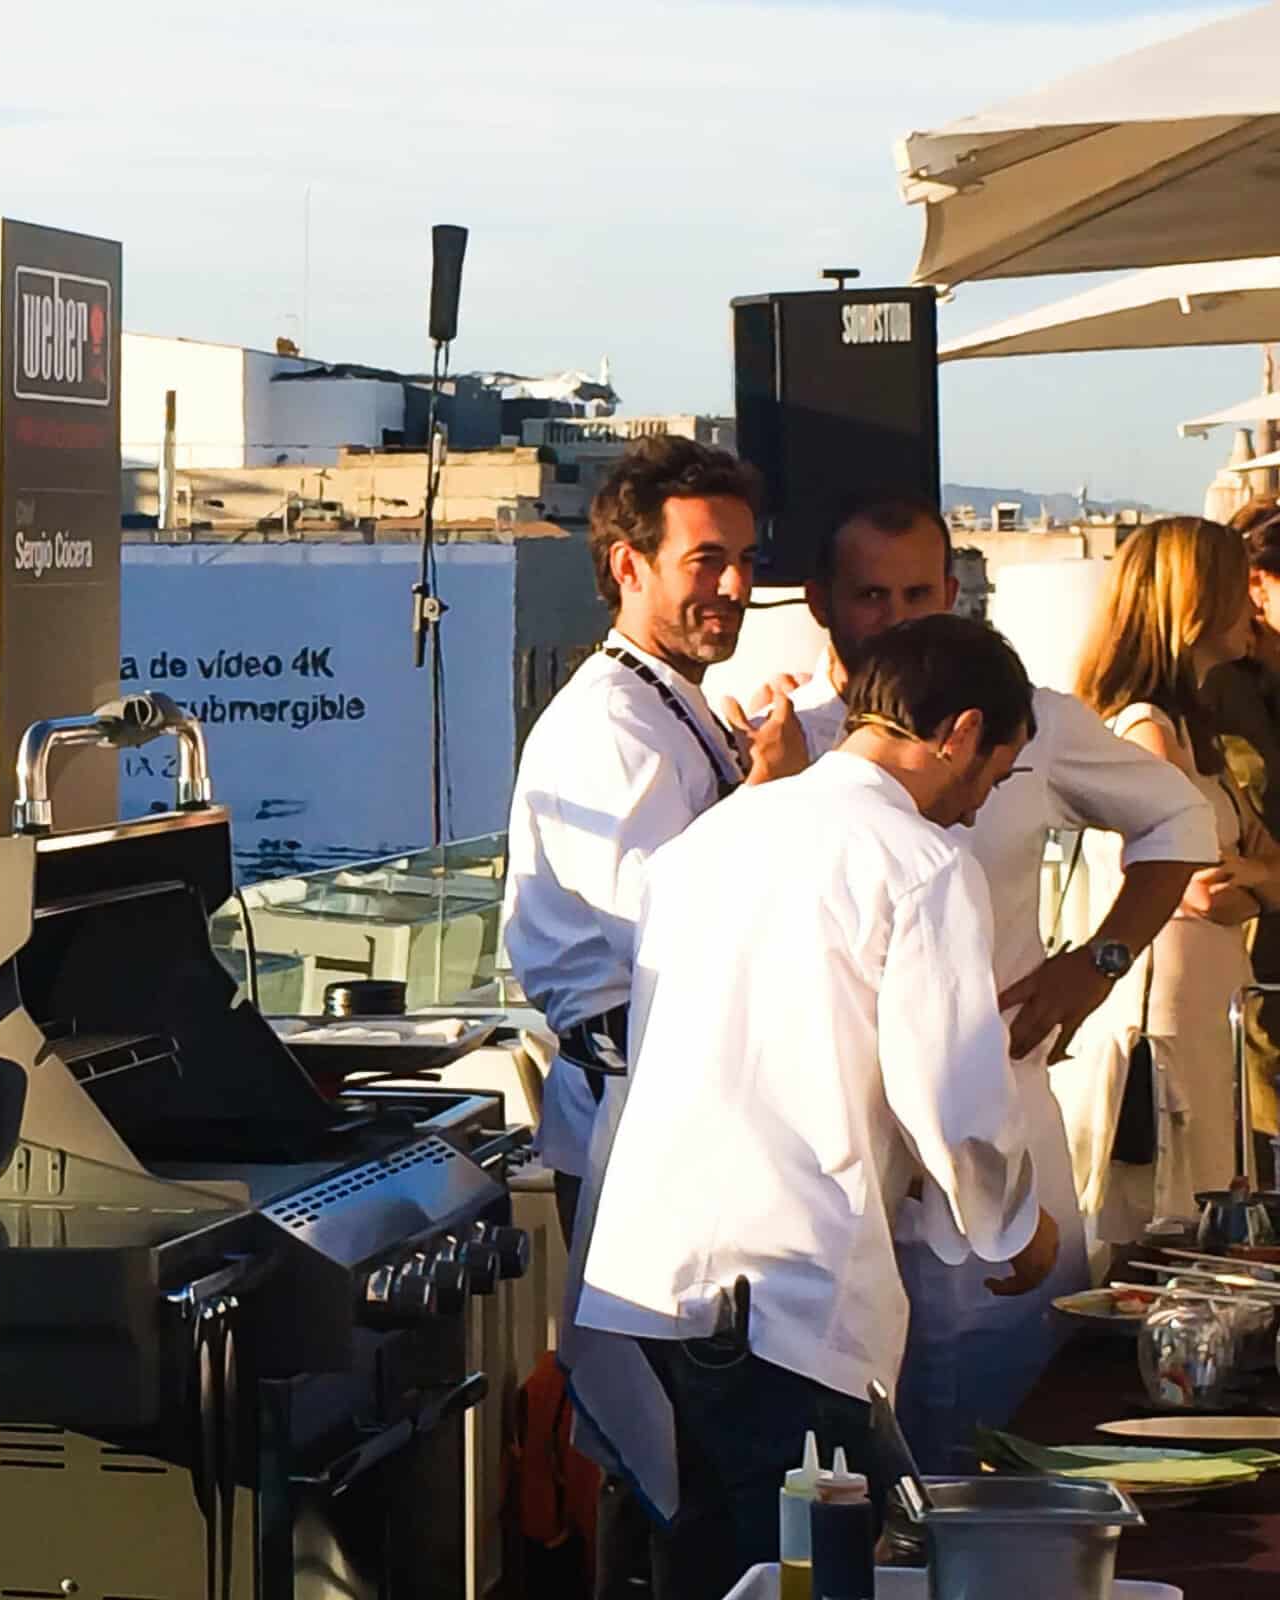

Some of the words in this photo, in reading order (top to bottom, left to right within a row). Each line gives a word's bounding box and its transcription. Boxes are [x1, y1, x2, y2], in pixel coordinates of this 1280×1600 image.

[23, 274, 88, 383] weber
[16, 531, 52, 577] Sergio
[149, 652, 188, 678] de
[197, 649, 282, 679] vídeo
[292, 647, 335, 678] 4K
